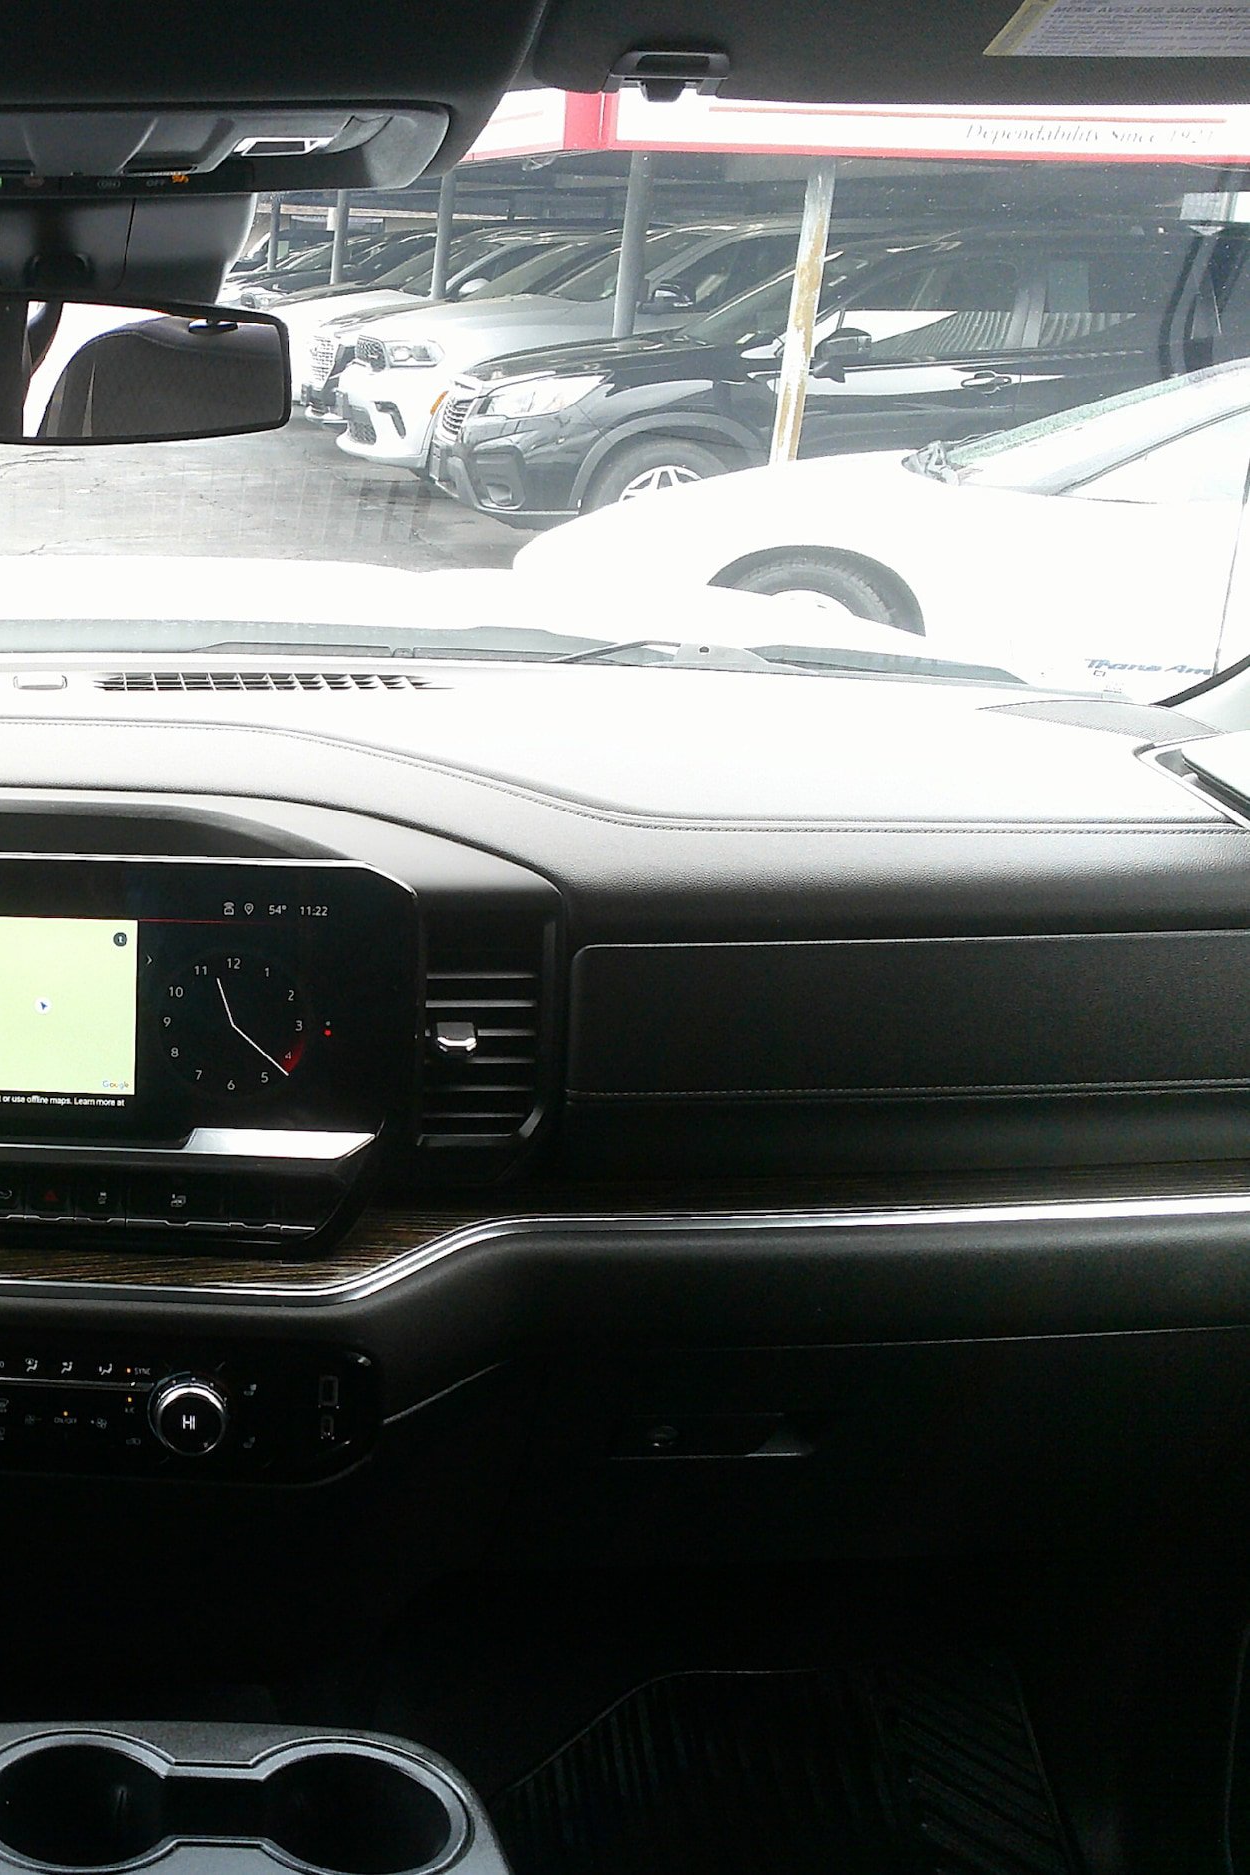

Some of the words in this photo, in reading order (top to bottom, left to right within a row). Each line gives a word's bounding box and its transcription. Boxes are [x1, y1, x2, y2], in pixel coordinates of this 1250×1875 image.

[965, 124, 1099, 144] Dependability
[300, 906, 328, 917] 11:22
[227, 958, 241, 969] 12
[194, 965, 208, 975] 11
[264, 967, 270, 977] 1
[169, 986, 184, 998] 10
[287, 990, 294, 1001] 2
[163, 1016, 171, 1027] 9
[295, 1020, 303, 1031] 3
[171, 1047, 179, 1058] 8
[284, 1051, 292, 1060] 4
[195, 1070, 203, 1080] 7
[261, 1072, 269, 1083] 5
[227, 1080, 235, 1090] 6
[26, 1095, 49, 1104] offline
[74, 1097, 96, 1105] Learn
[96, 1098, 115, 1106] more
[116, 1099, 125, 1107] at
[182, 1415, 196, 1430] HI
